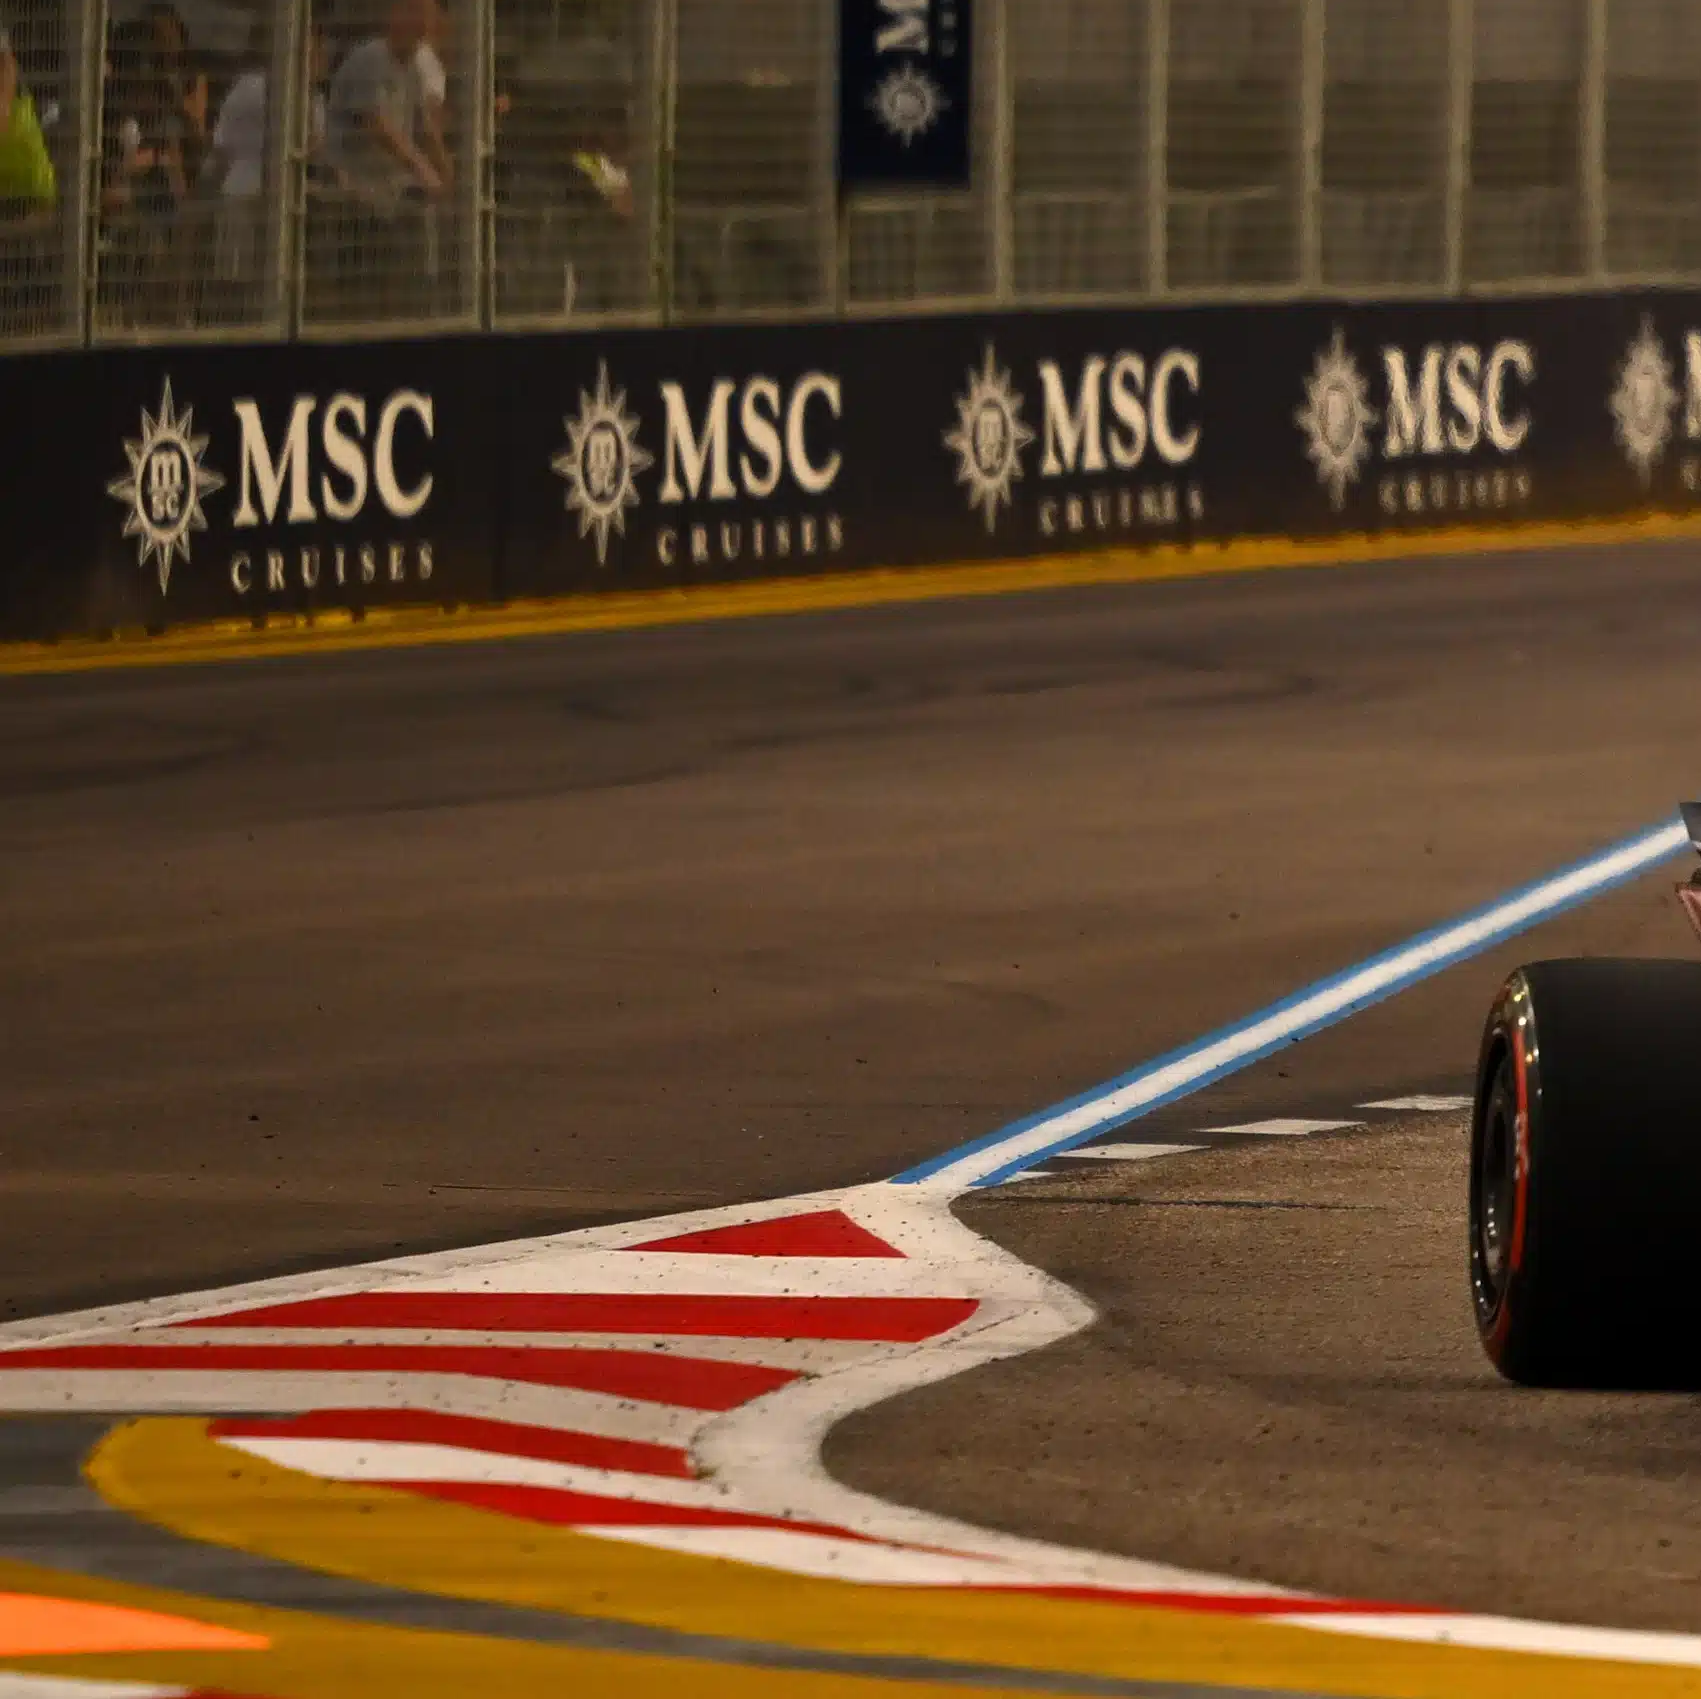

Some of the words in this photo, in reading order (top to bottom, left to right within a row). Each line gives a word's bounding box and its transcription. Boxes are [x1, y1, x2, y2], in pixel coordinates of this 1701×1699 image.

[233, 389, 434, 527] MSC
[658, 371, 842, 503] MSC
[1039, 348, 1199, 476] MSC
[1382, 340, 1534, 458] MSC
[231, 542, 433, 593] CRUISES
